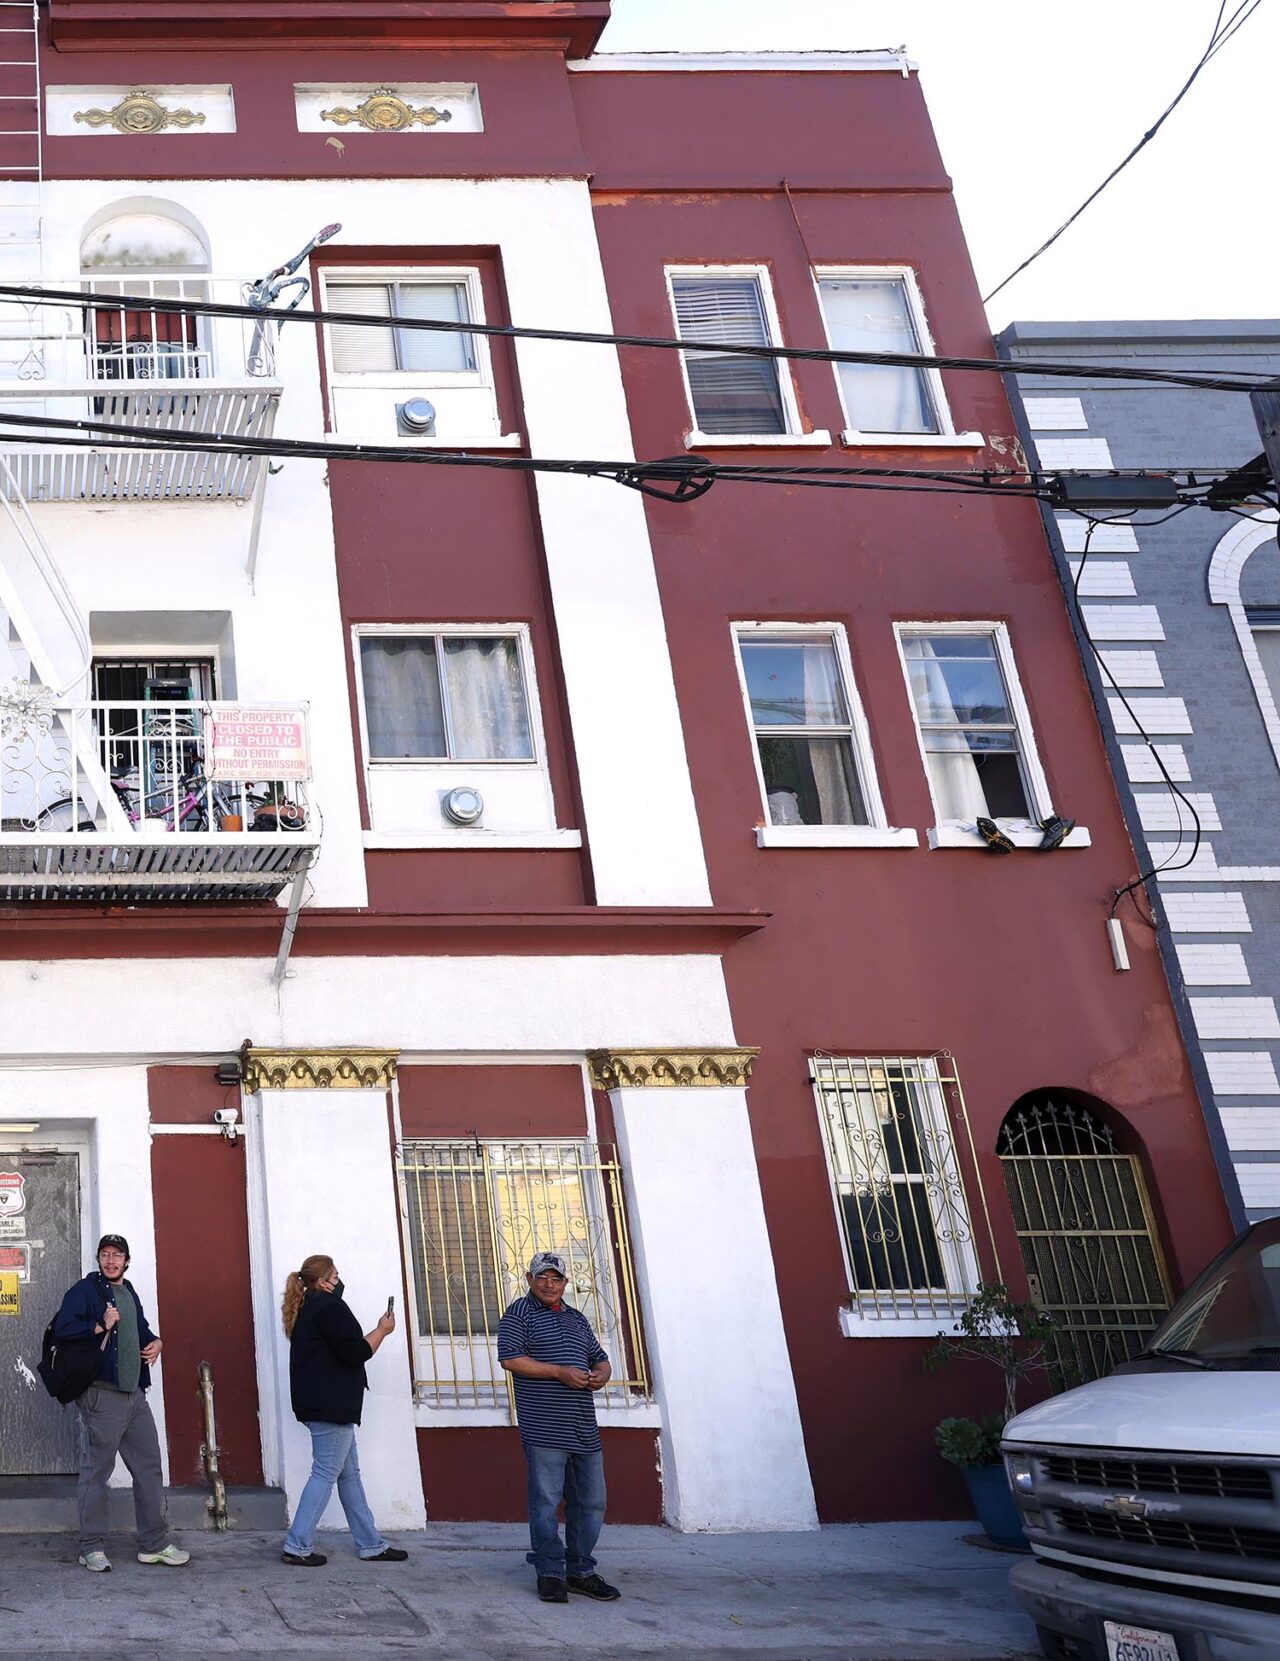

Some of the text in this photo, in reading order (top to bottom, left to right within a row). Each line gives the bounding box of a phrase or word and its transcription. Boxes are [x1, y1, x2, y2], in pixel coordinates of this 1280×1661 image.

[216, 712, 294, 722] THIS PROPERTY
[218, 725, 294, 735] CLOSED TO
[217, 735, 297, 746] THE PUBLIC
[233, 749, 280, 758] NO ENTRY
[210, 759, 306, 769] WITHOUT PERMISSION
